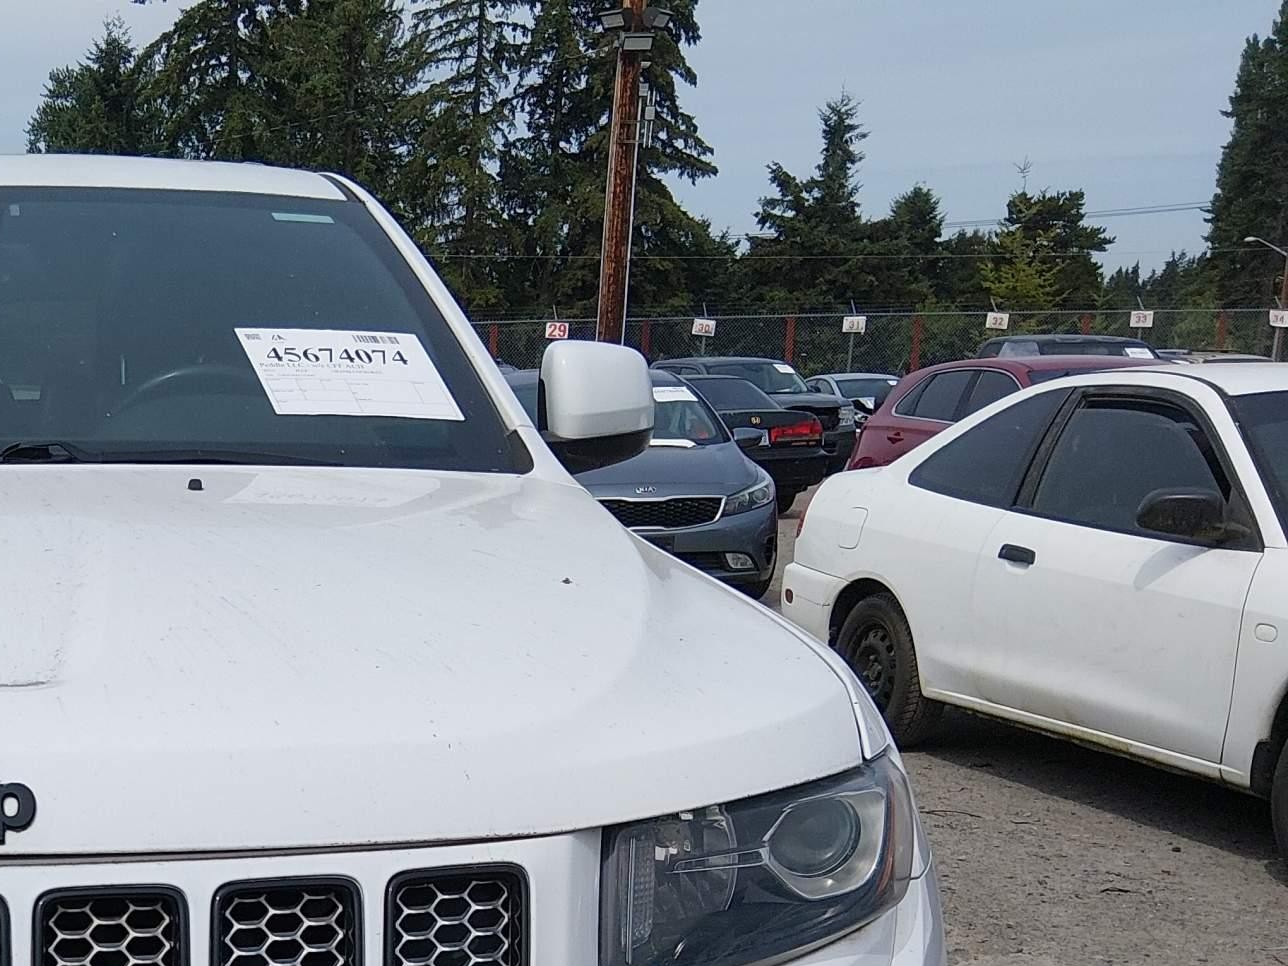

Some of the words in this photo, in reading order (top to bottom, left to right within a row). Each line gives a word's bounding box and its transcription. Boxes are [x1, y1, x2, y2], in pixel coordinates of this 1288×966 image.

[992, 317, 1004, 326] 32
[548, 323, 567, 337] 29
[698, 323, 710, 333] 30
[267, 347, 408, 366] 45674074
